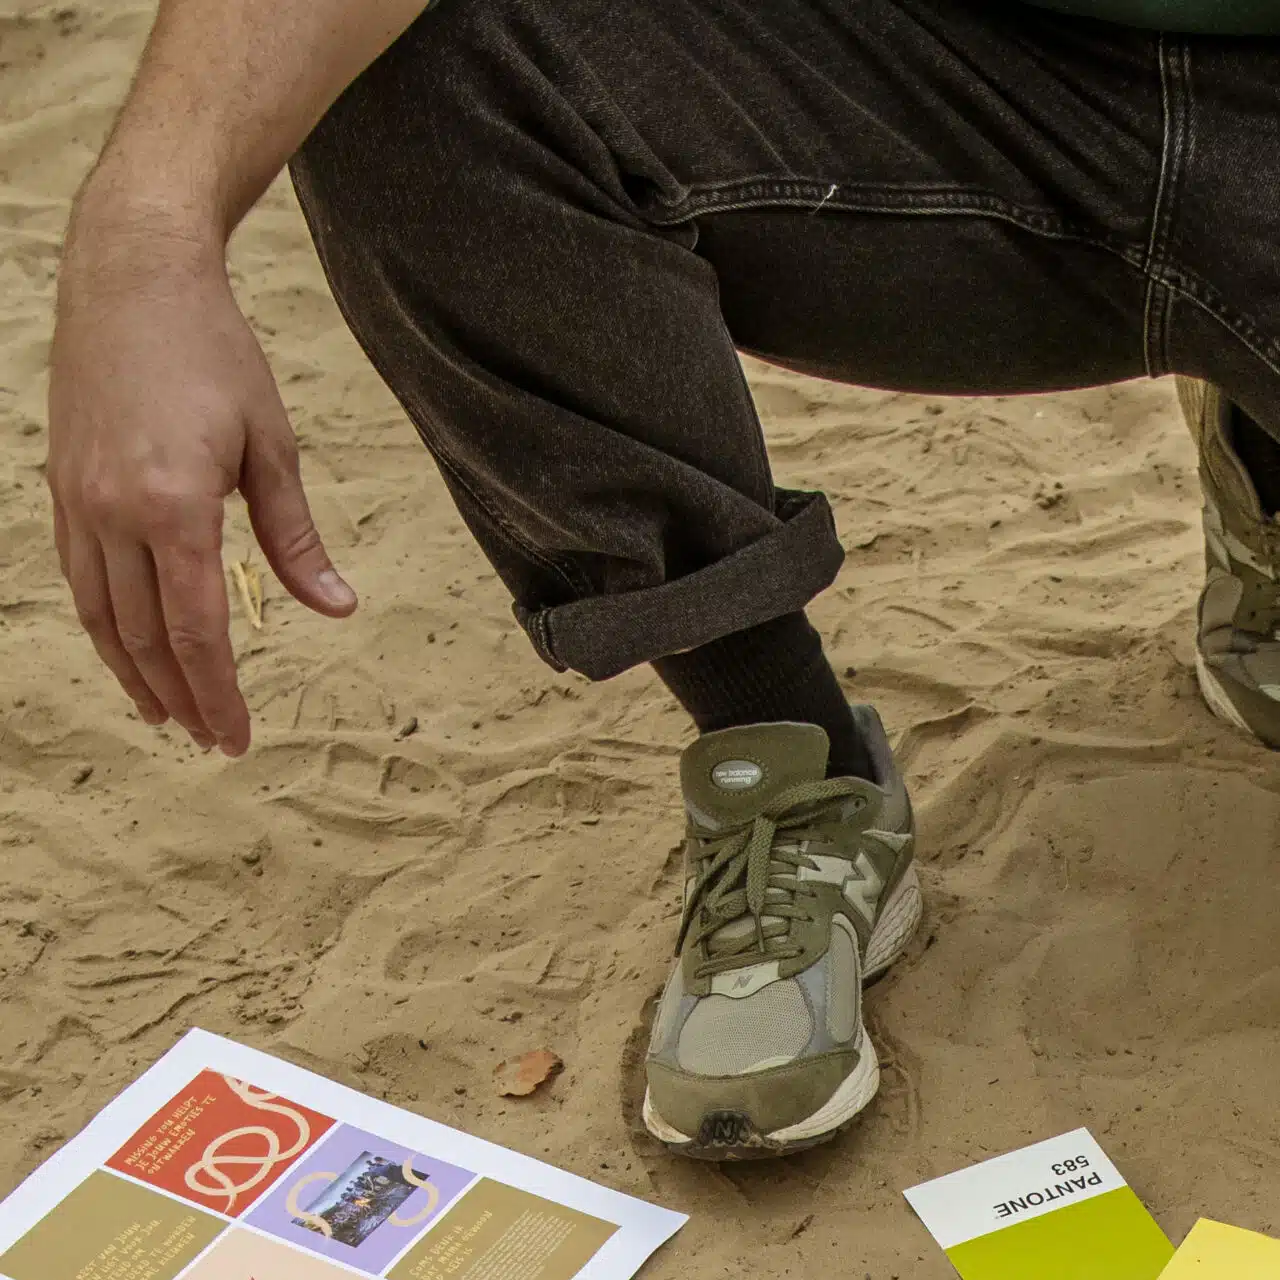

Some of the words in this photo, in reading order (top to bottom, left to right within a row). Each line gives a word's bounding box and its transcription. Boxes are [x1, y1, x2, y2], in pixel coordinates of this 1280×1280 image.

[124, 1135, 157, 1166] MISSING
[1051, 1155, 1090, 1176] 583
[993, 1171, 1103, 1218] PANTONE
